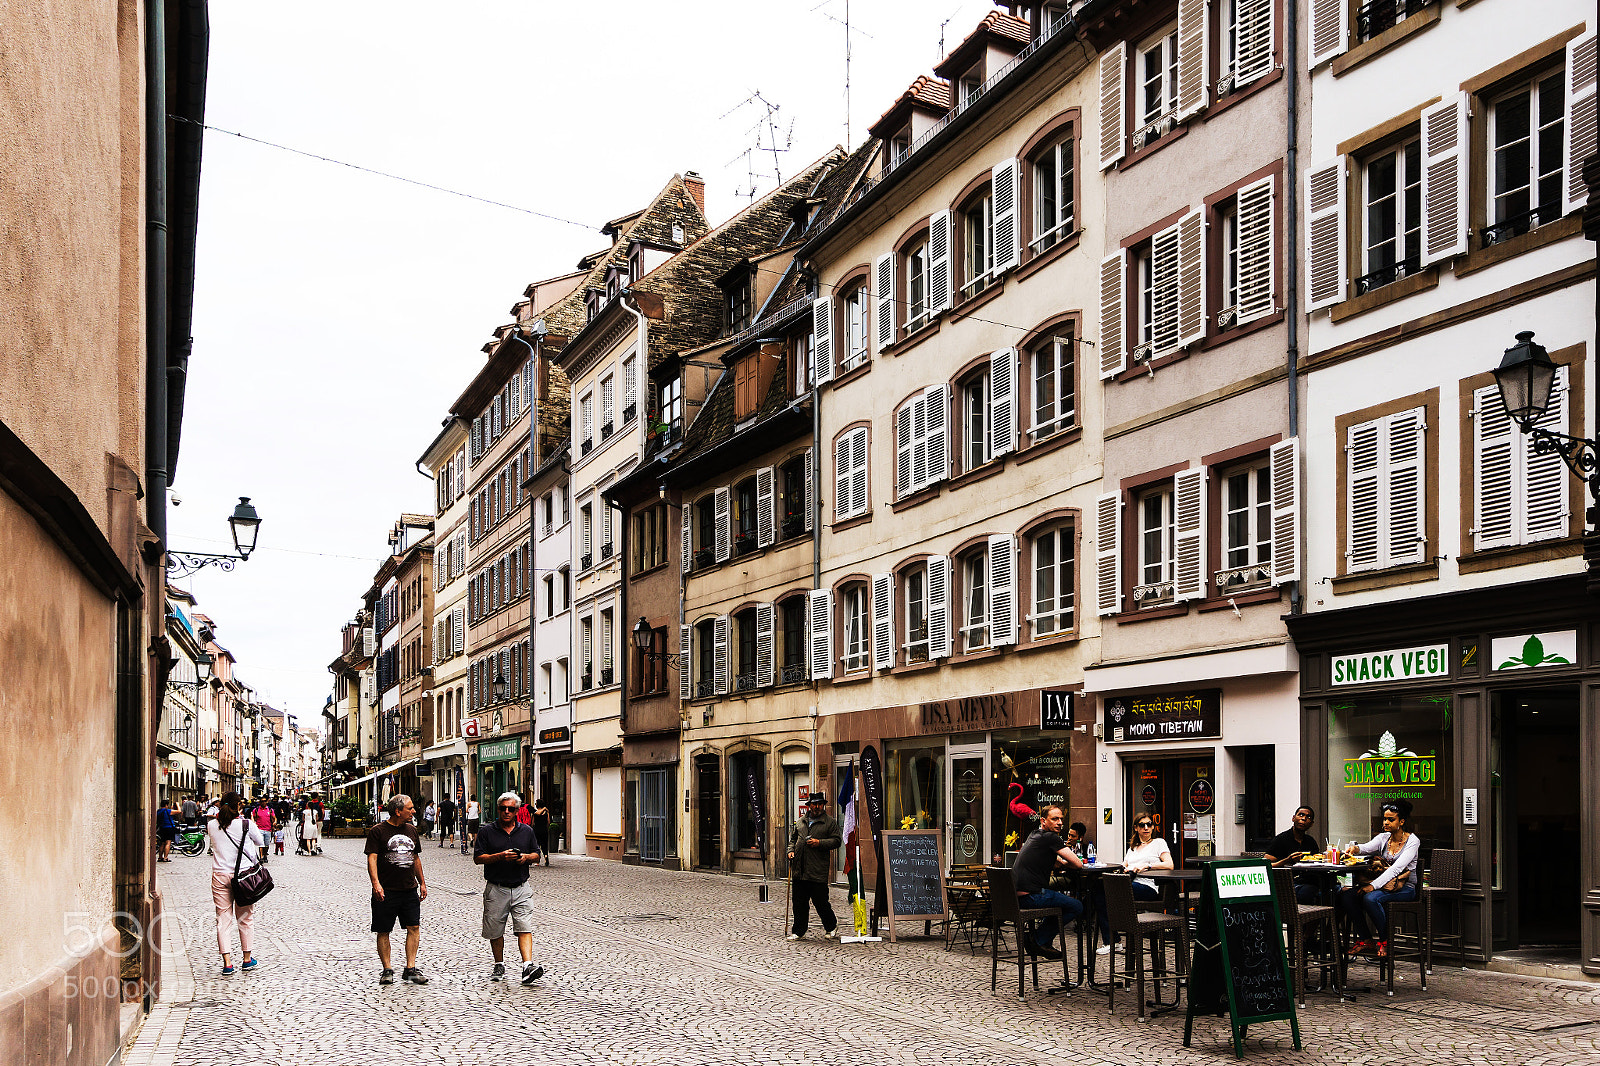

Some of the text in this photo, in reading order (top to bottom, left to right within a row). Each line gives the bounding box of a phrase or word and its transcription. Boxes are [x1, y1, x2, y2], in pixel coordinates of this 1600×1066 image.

[1335, 648, 1445, 682] SNACK VEGI
[922, 694, 1008, 726] LISA MEYER
[1129, 720, 1203, 736] MOMO TIBETAIN
[1344, 760, 1436, 783] SNACK VEGI
[1220, 873, 1265, 887] SNACK VEGI
[1222, 907, 1266, 928] Burger
